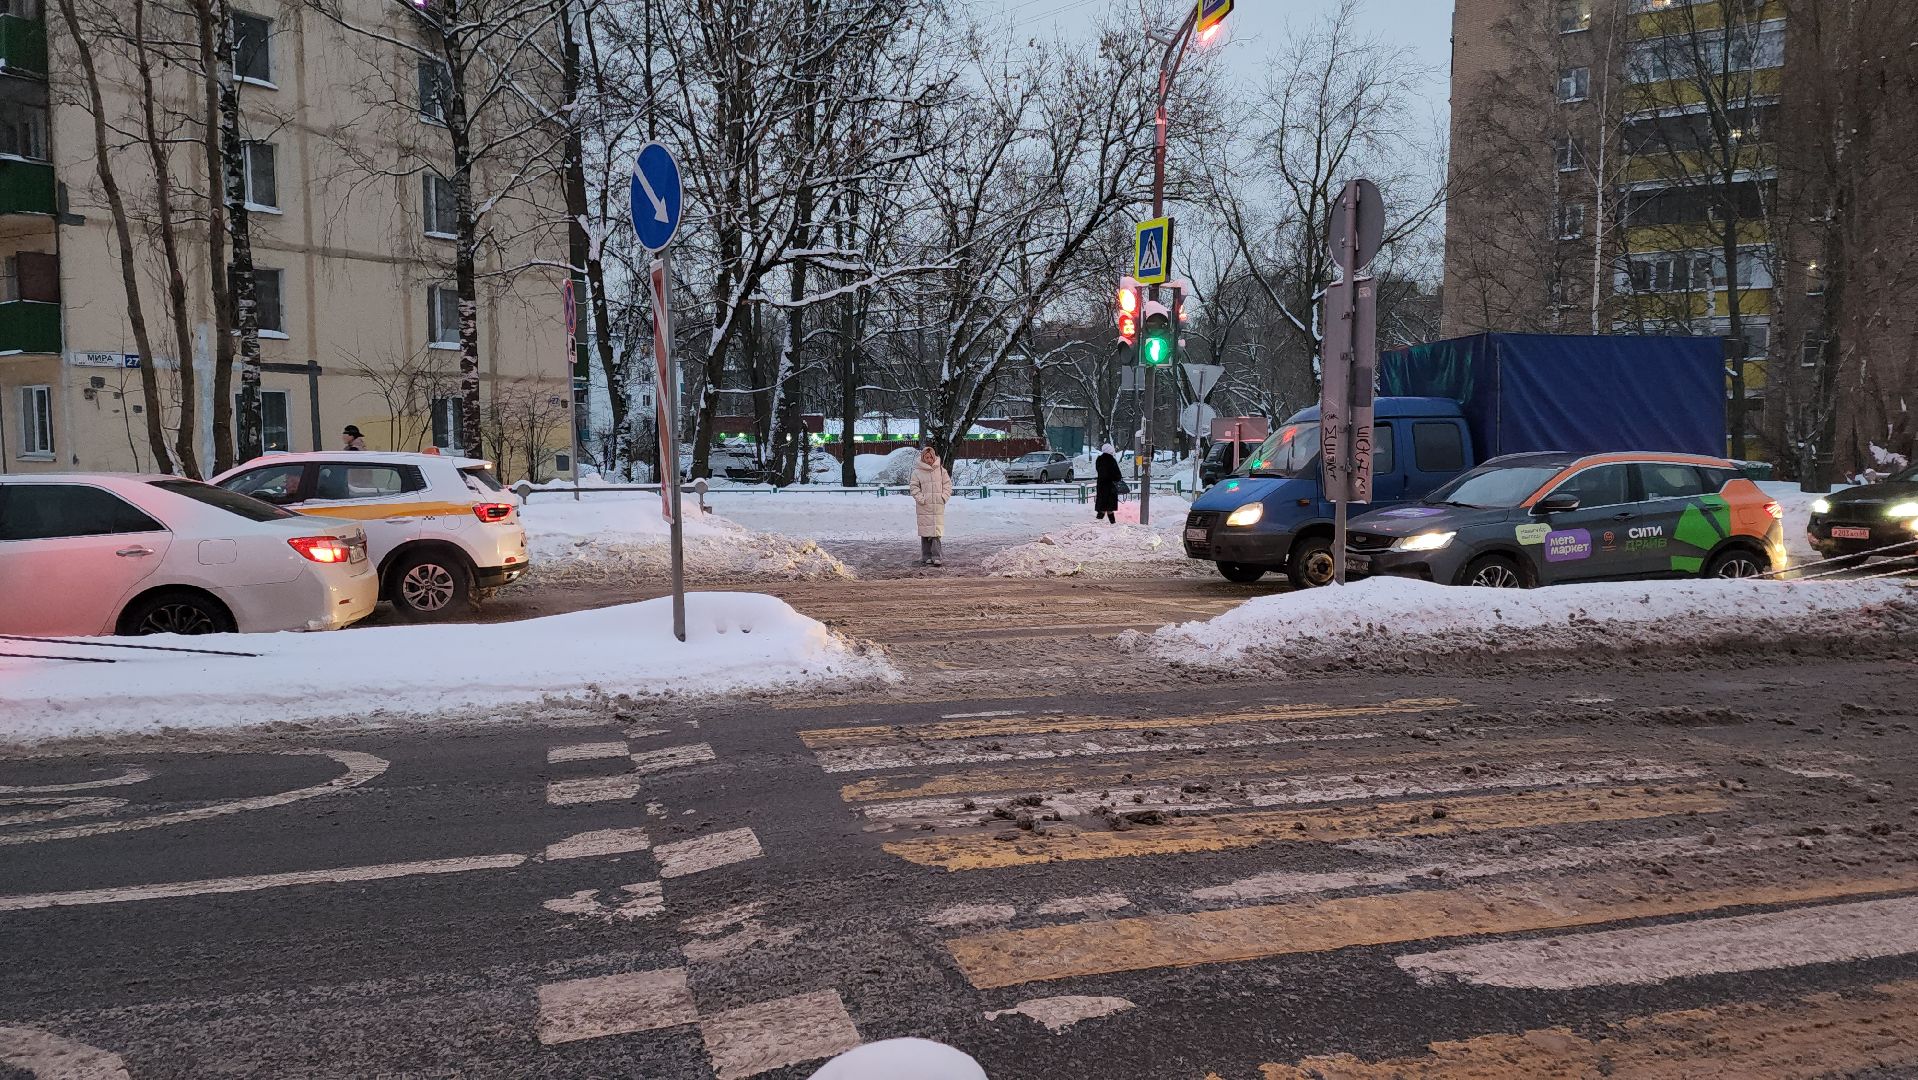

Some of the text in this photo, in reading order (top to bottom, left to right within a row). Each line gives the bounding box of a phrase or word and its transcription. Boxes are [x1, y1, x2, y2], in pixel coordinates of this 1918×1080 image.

[87, 354, 113, 362] МИРА
[126, 357, 140, 366] 27
[1628, 525, 1663, 539] СИТИ
[1550, 543, 1590, 556] маркет
[1624, 537, 1668, 552] ДРАЙВ
